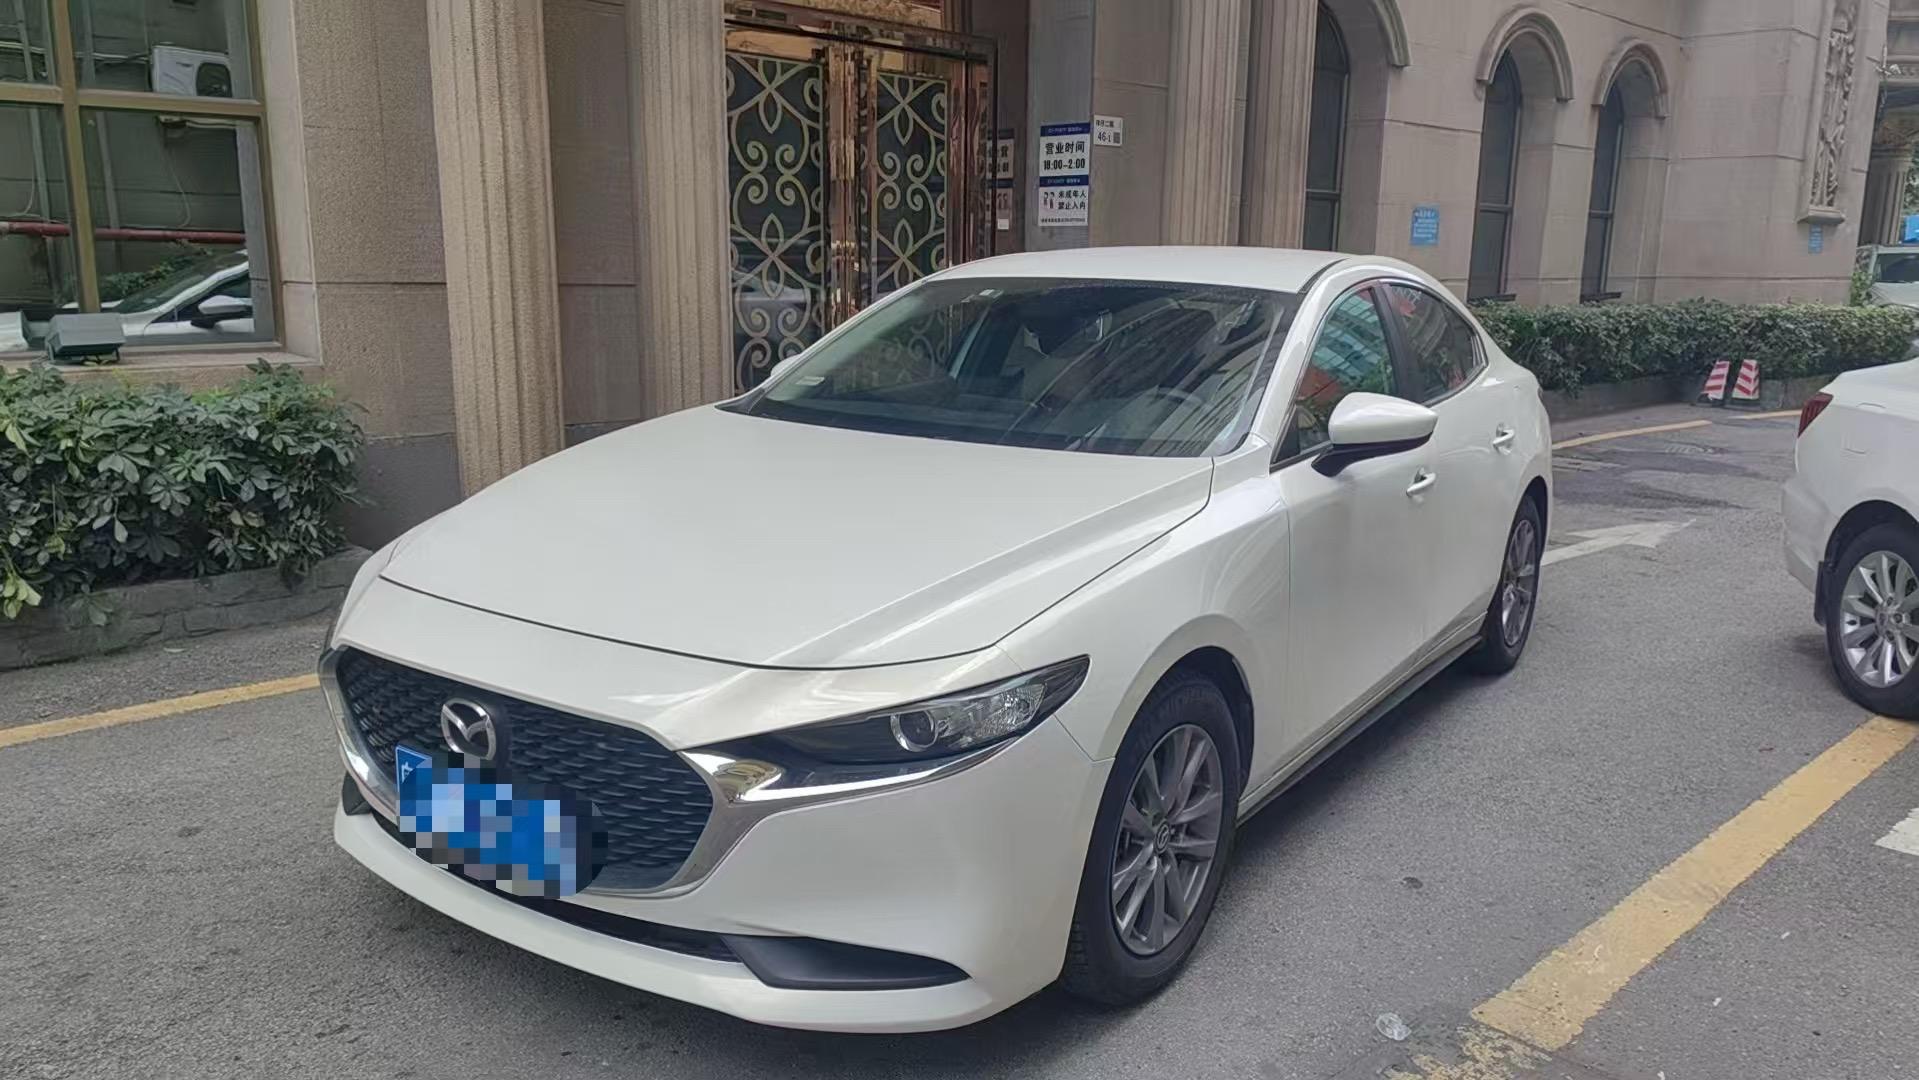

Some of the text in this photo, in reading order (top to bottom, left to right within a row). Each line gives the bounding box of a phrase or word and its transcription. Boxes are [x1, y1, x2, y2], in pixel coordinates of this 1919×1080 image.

[1045, 141, 1085, 155] 营业时间
[1044, 158, 1085, 170] 18:00-2:00
[1058, 189, 1086, 198] 未成年人
[1058, 201, 1086, 210] 禁止入内
